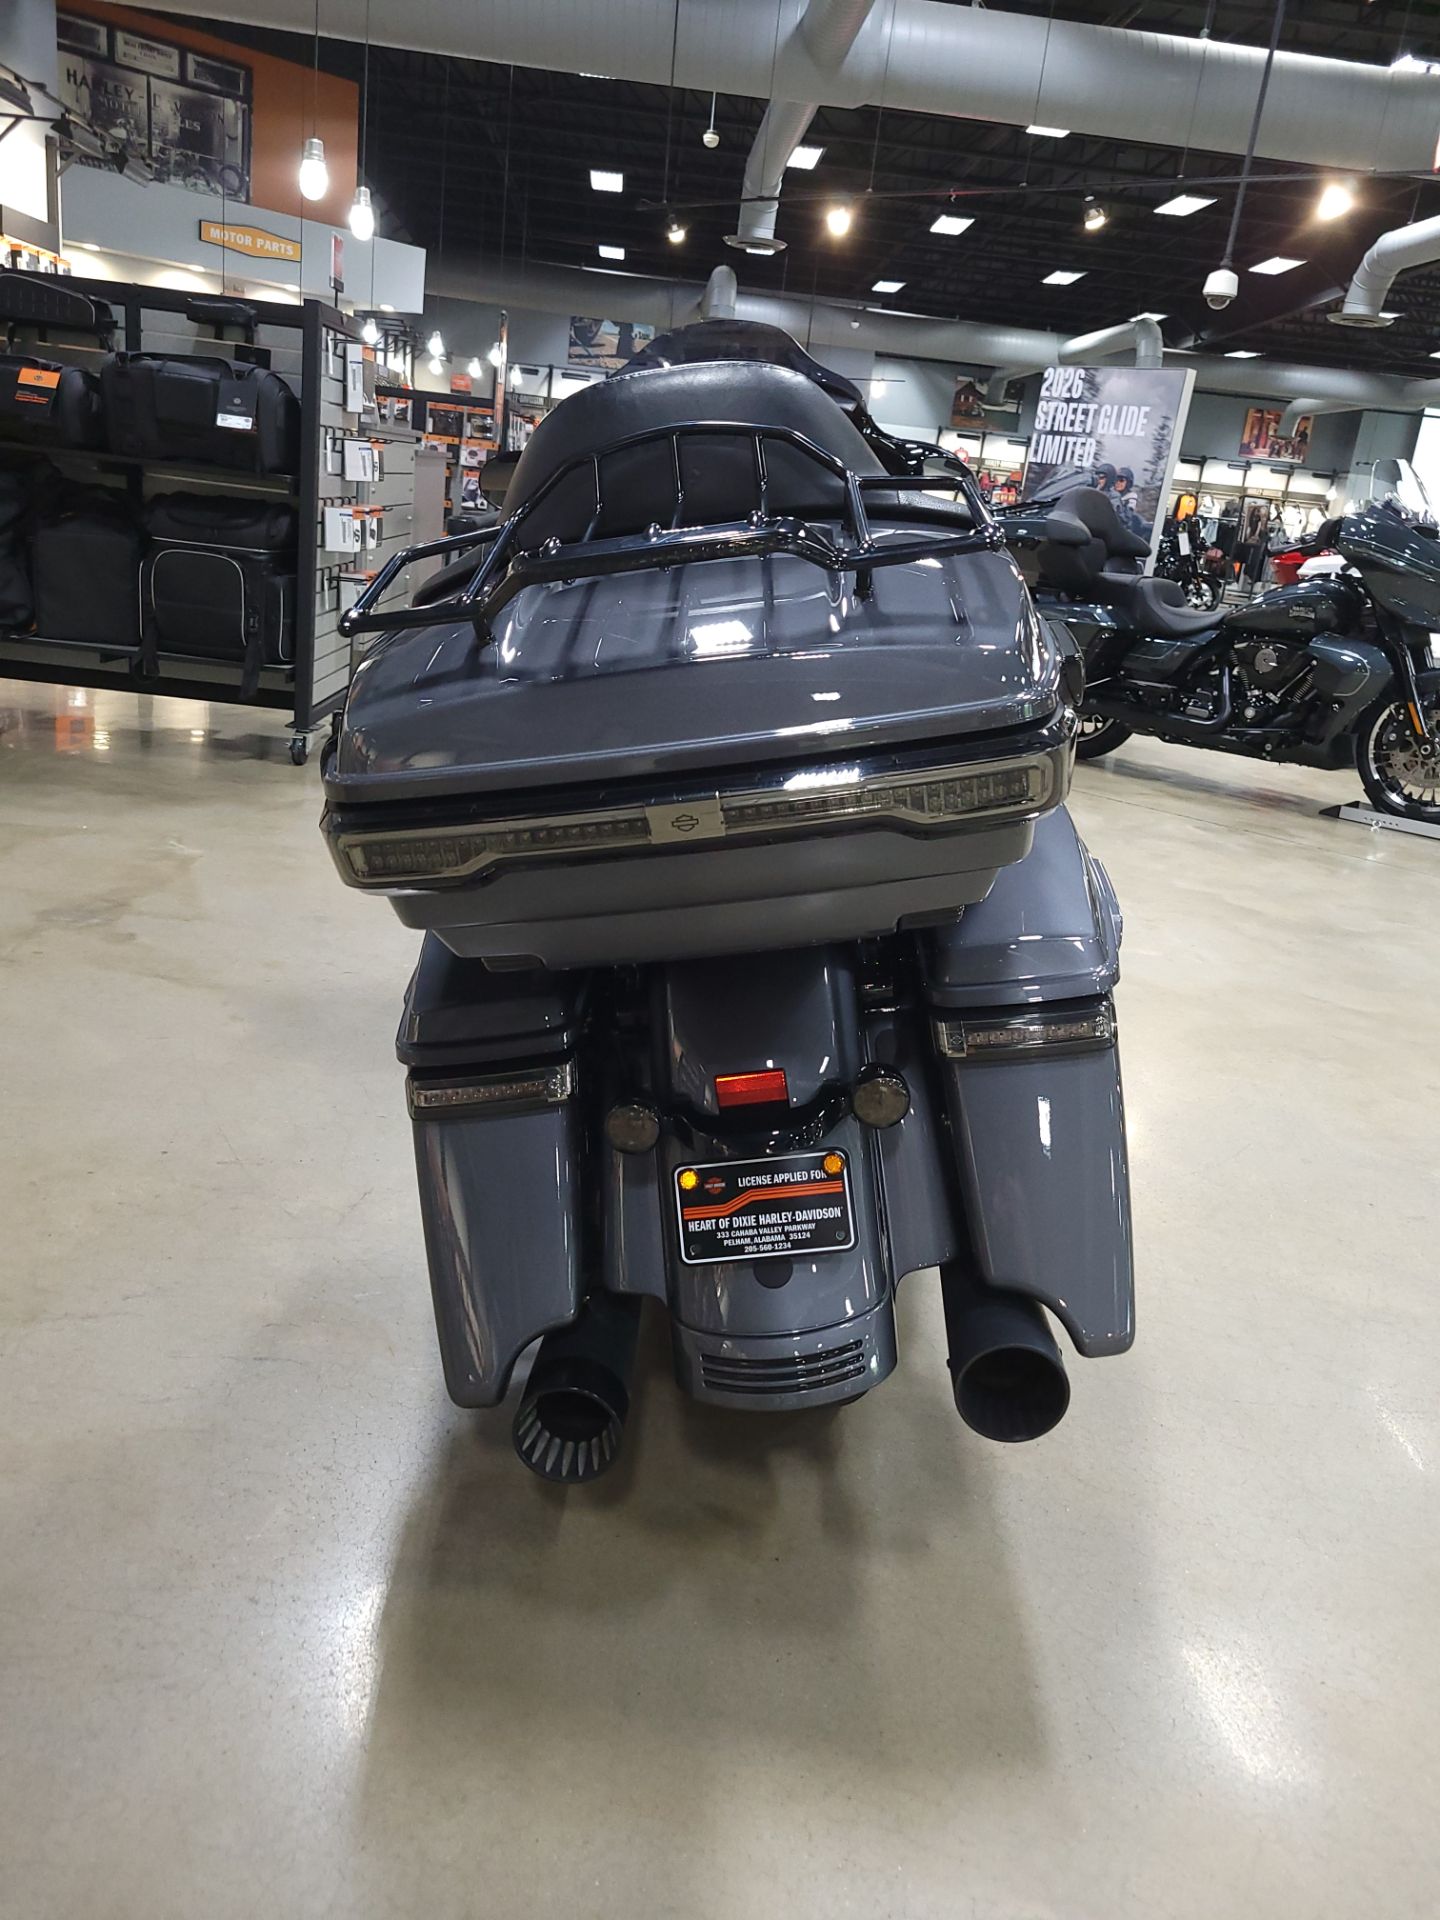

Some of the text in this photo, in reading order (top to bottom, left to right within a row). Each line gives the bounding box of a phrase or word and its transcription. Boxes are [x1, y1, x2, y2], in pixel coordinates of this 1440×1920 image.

[210, 227, 294, 256] MOTOR PARTS
[1041, 367, 1086, 399] 2026
[1034, 401, 1151, 437] STREET GLIDE
[1029, 433, 1096, 469] LIMITED
[737, 1174, 772, 1188] LICENSE
[773, 1170, 808, 1184] APPLIED
[688, 1206, 842, 1232] HEART OF DIXIE HARLEY-DAVIDSON
[716, 1222, 816, 1239] 333 CAHABA VALLEY PARKWAY
[723, 1231, 811, 1247] PELHAM, ALABAMA 35124
[744, 1241, 792, 1253] 205-560-1234
